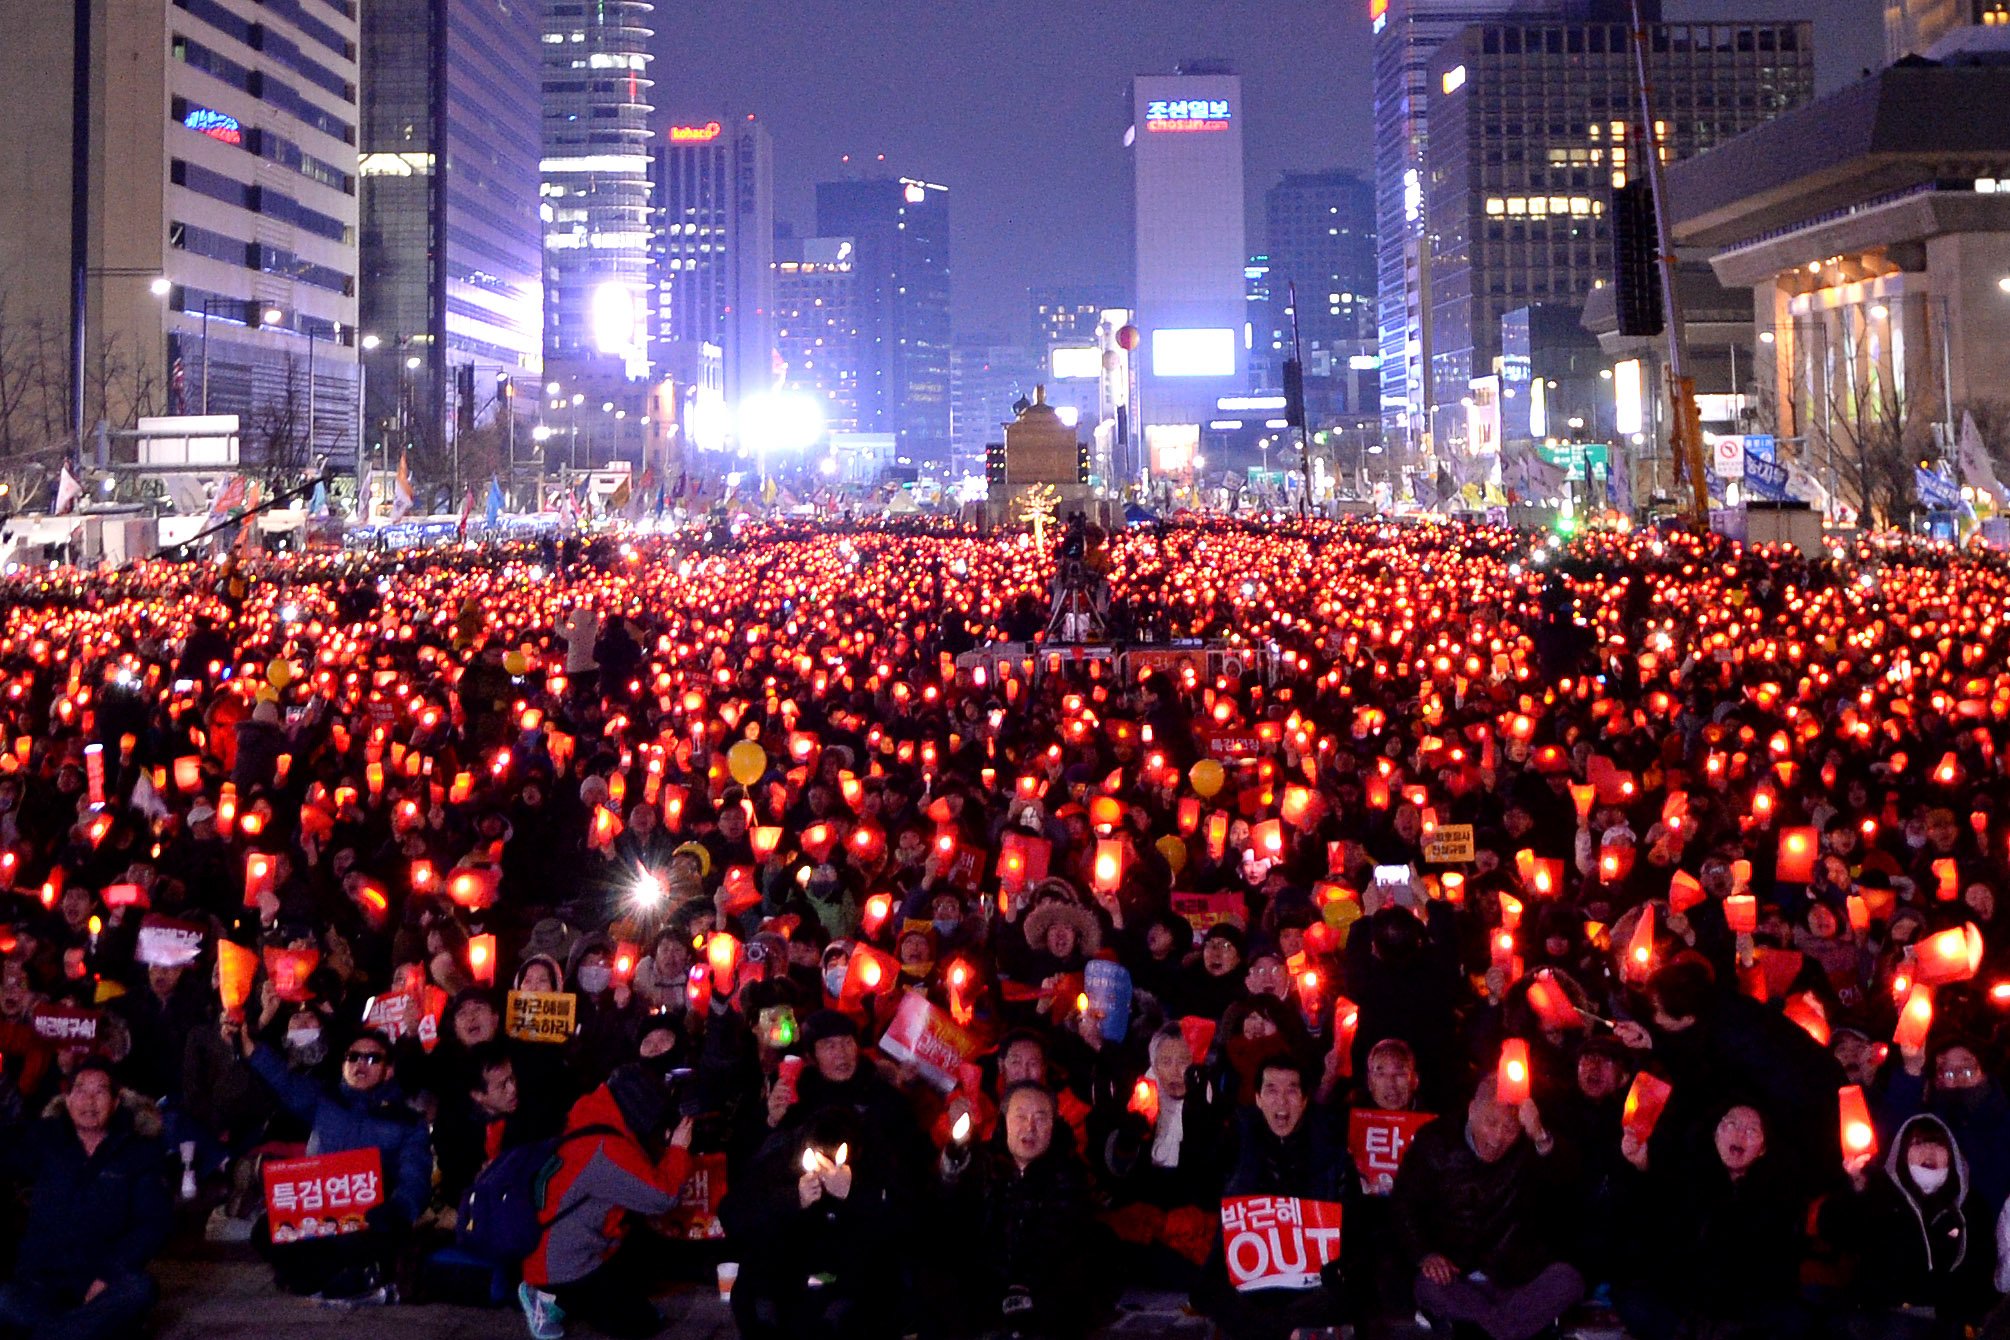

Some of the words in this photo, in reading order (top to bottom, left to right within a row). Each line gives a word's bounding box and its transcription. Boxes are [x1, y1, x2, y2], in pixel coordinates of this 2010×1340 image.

[1146, 100, 1231, 119] 조선일보
[513, 998, 570, 1015] 박근혜를
[512, 1017, 569, 1035] 구속하라
[1366, 1126, 1415, 1170] 탄
[272, 1171, 378, 1212] 특검연장
[1221, 1196, 1303, 1232] 박근혜
[1227, 1226, 1340, 1281] OUT
